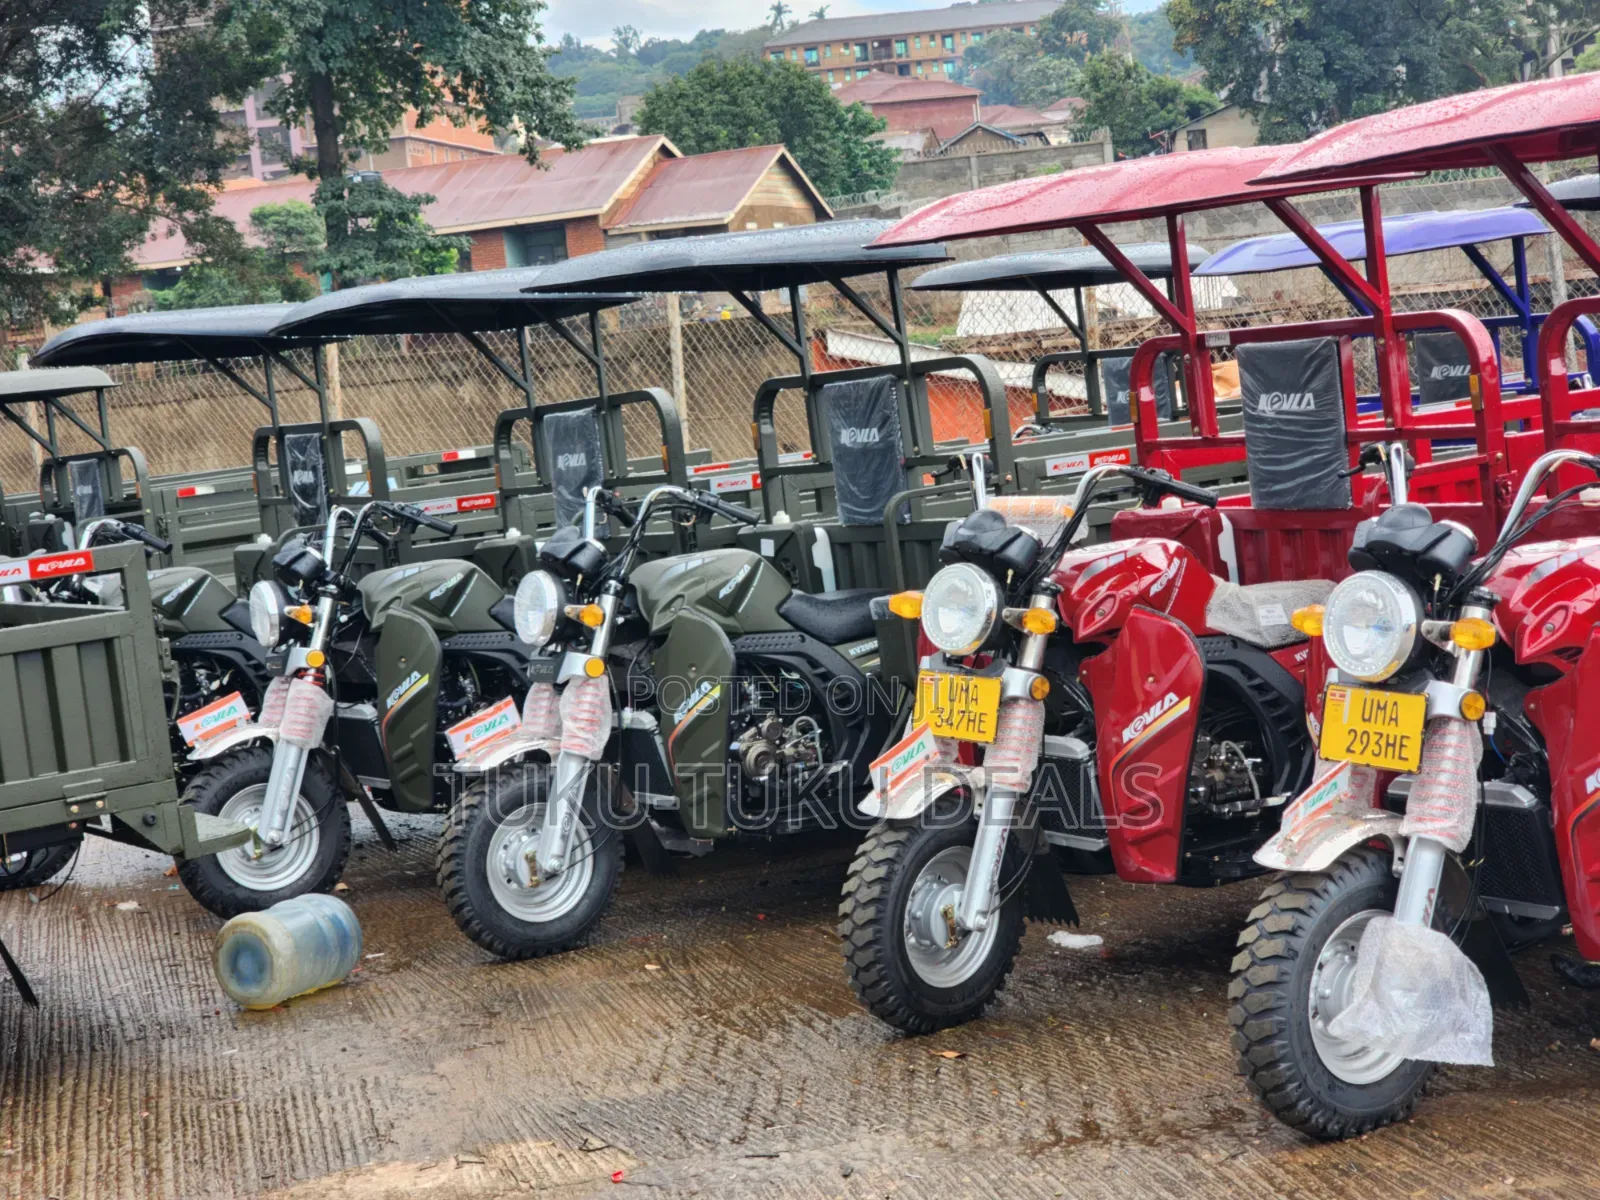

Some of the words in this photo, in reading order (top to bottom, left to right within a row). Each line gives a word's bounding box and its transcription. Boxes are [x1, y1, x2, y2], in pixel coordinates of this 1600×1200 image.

[948, 679, 980, 706] UMA
[934, 706, 988, 734] 347HE
[1361, 697, 1399, 728] UMA
[1345, 728, 1412, 762] 293HE
